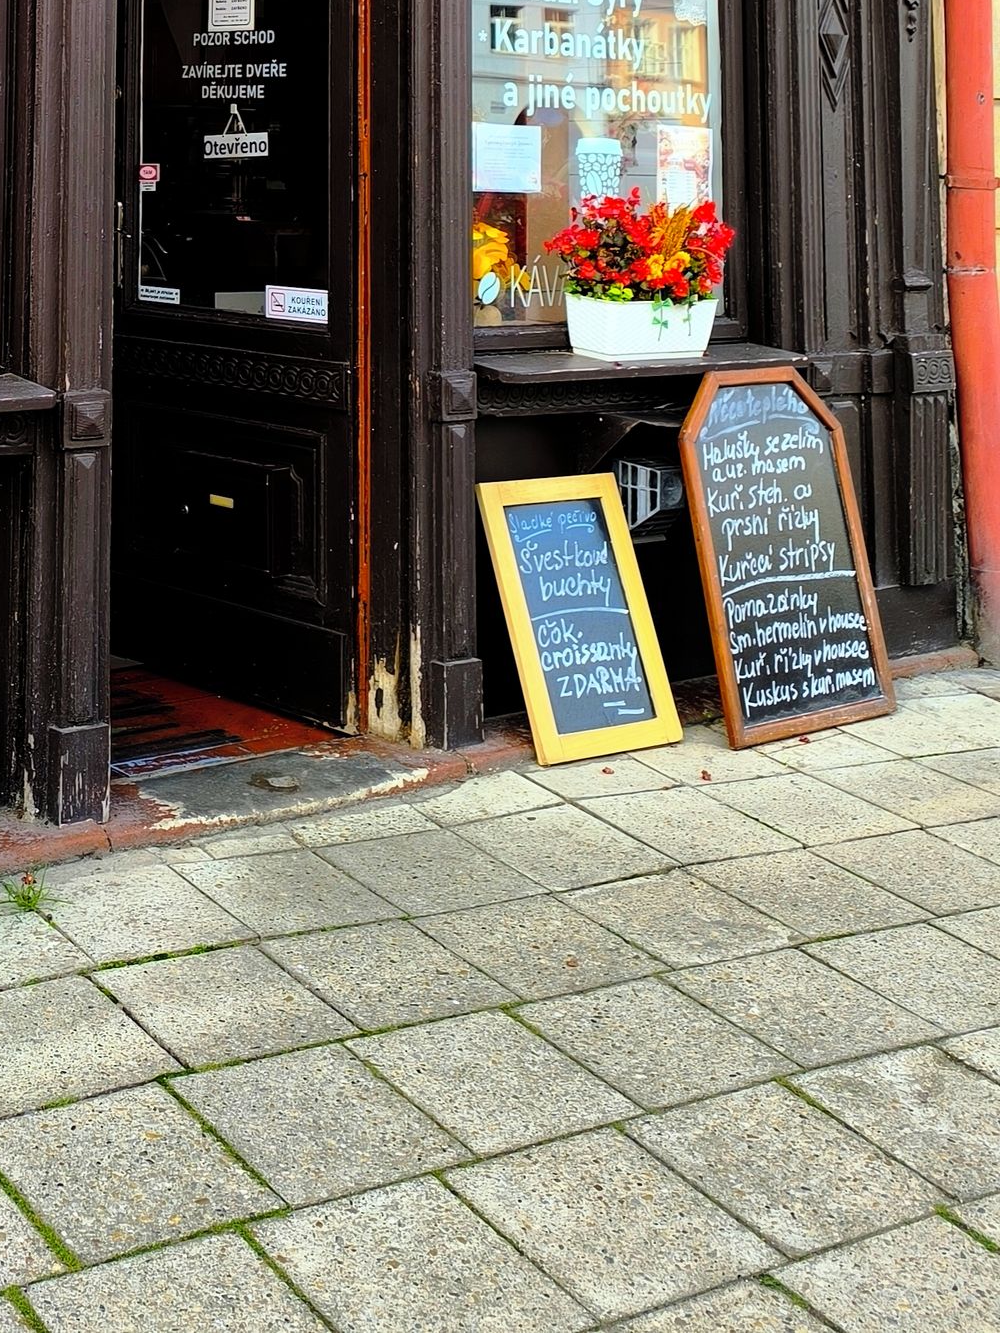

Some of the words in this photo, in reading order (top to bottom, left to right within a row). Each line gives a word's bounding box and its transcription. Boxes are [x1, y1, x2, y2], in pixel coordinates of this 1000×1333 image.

[193, 32, 230, 46] POZOR
[234, 30, 275, 45] SCHOD
[495, 19, 645, 69] Karbanátky
[182, 61, 243, 78] ZAVÍREJTE
[246, 59, 287, 78] DVEŘE
[201, 81, 265, 99] DĚKUJEME
[503, 81, 518, 107] a
[527, 73, 576, 116] jiné
[586, 79, 712, 123] pochoutky
[204, 137, 267, 156] Otevřeno
[511, 255, 565, 307] KÁV
[288, 305, 326, 316] ZAKÁZÁNO
[291, 296, 323, 306] KOUŘENÍ
[703, 430, 760, 470] Halušky
[764, 435, 780, 456] se
[712, 467, 727, 482] a
[752, 455, 806, 476] masem
[794, 483, 812, 500] a
[509, 511, 554, 534] Sladké
[721, 506, 772, 552] prsní
[779, 504, 820, 544] řízky
[520, 540, 608, 574] Švestkové
[719, 544, 773, 587] Kuřecí
[539, 569, 611, 607] buchty
[723, 586, 818, 629] Pomazánky
[755, 612, 817, 647] hermelín
[541, 631, 638, 672] croissanty
[557, 665, 642, 698] ZDARMA
[743, 681, 799, 718] Kuskus
[835, 666, 876, 692] masem
